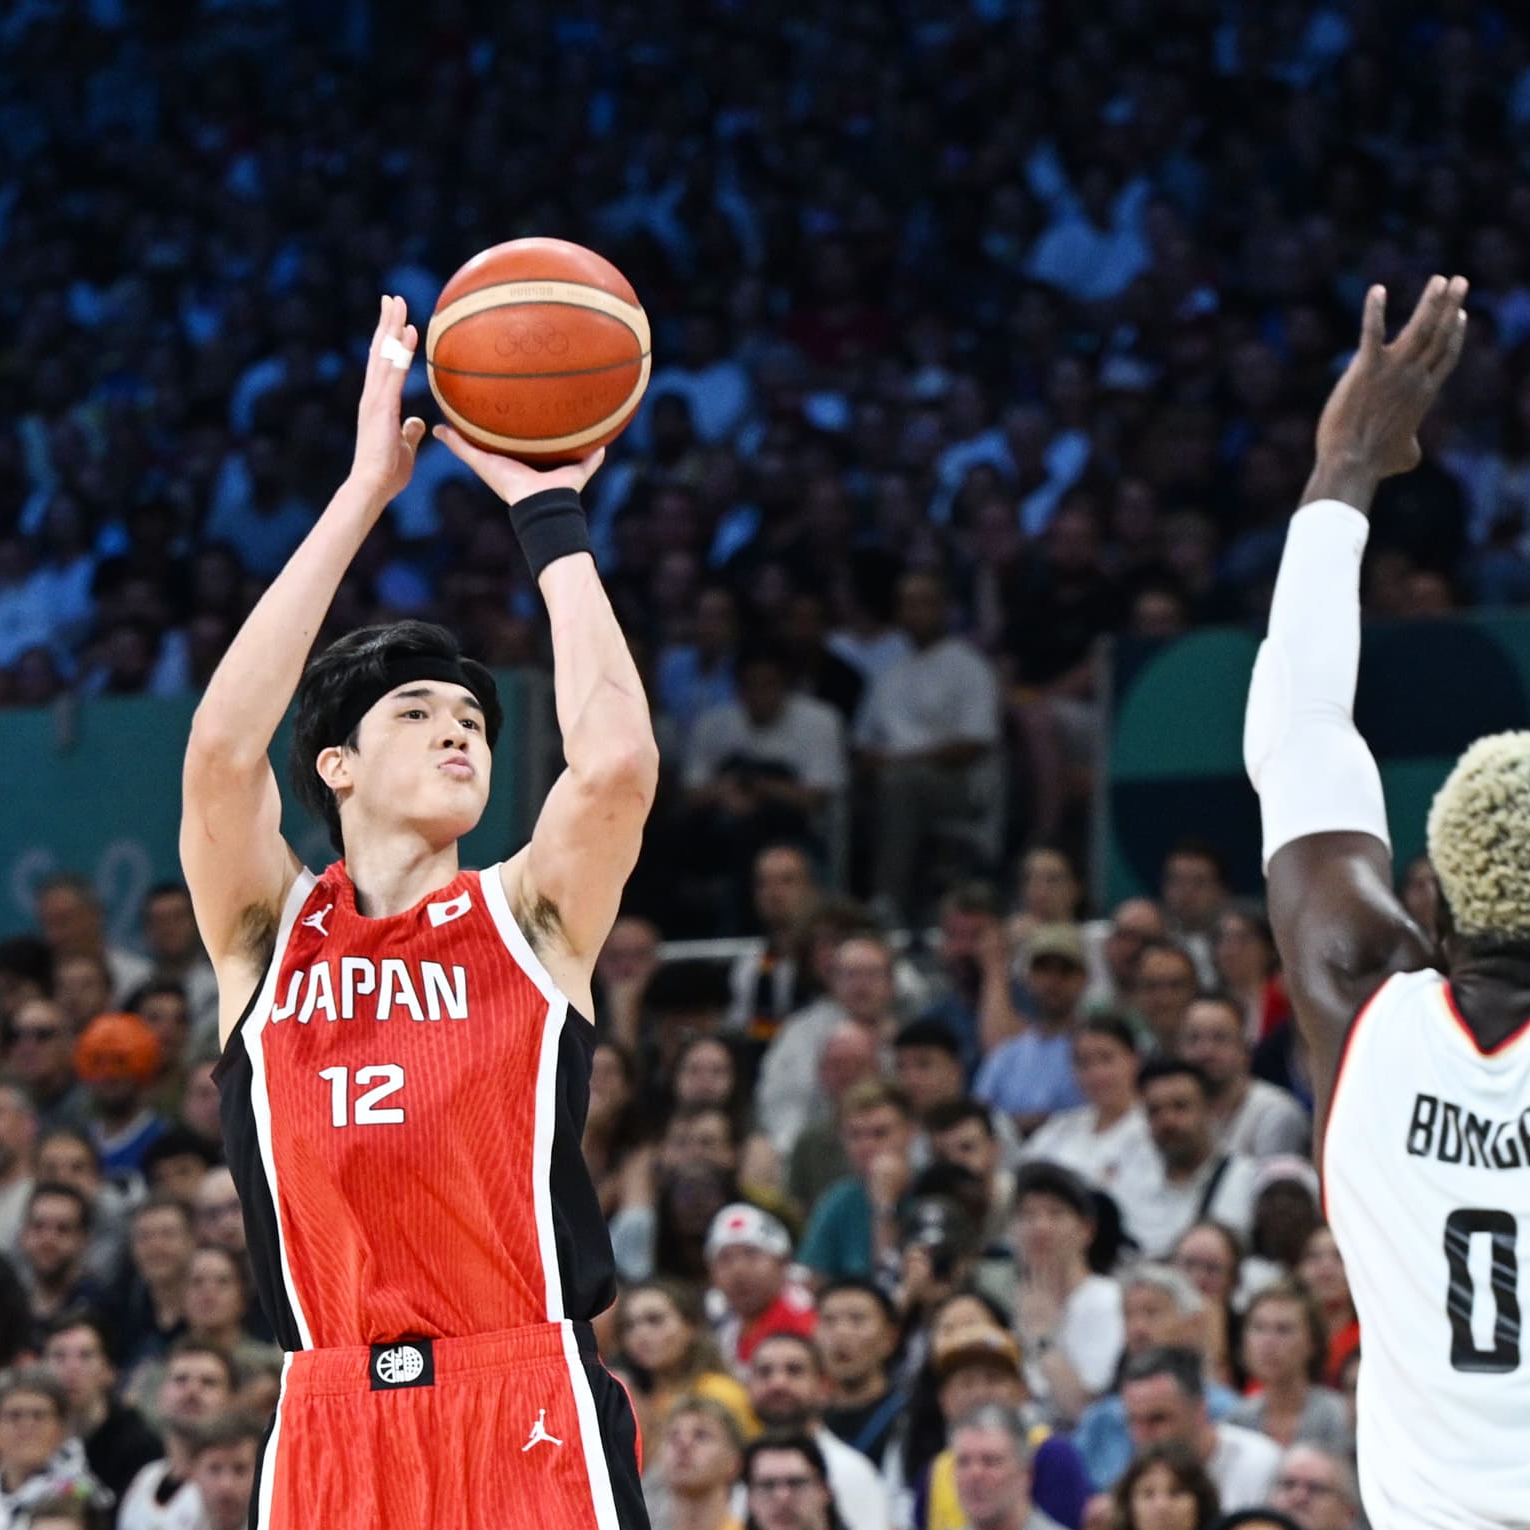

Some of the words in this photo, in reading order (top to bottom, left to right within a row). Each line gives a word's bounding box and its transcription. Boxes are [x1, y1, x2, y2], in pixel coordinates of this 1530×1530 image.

[271, 957, 469, 1025] JAPAN
[319, 1064, 405, 1128] 12
[1443, 1208, 1521, 1374] 0
